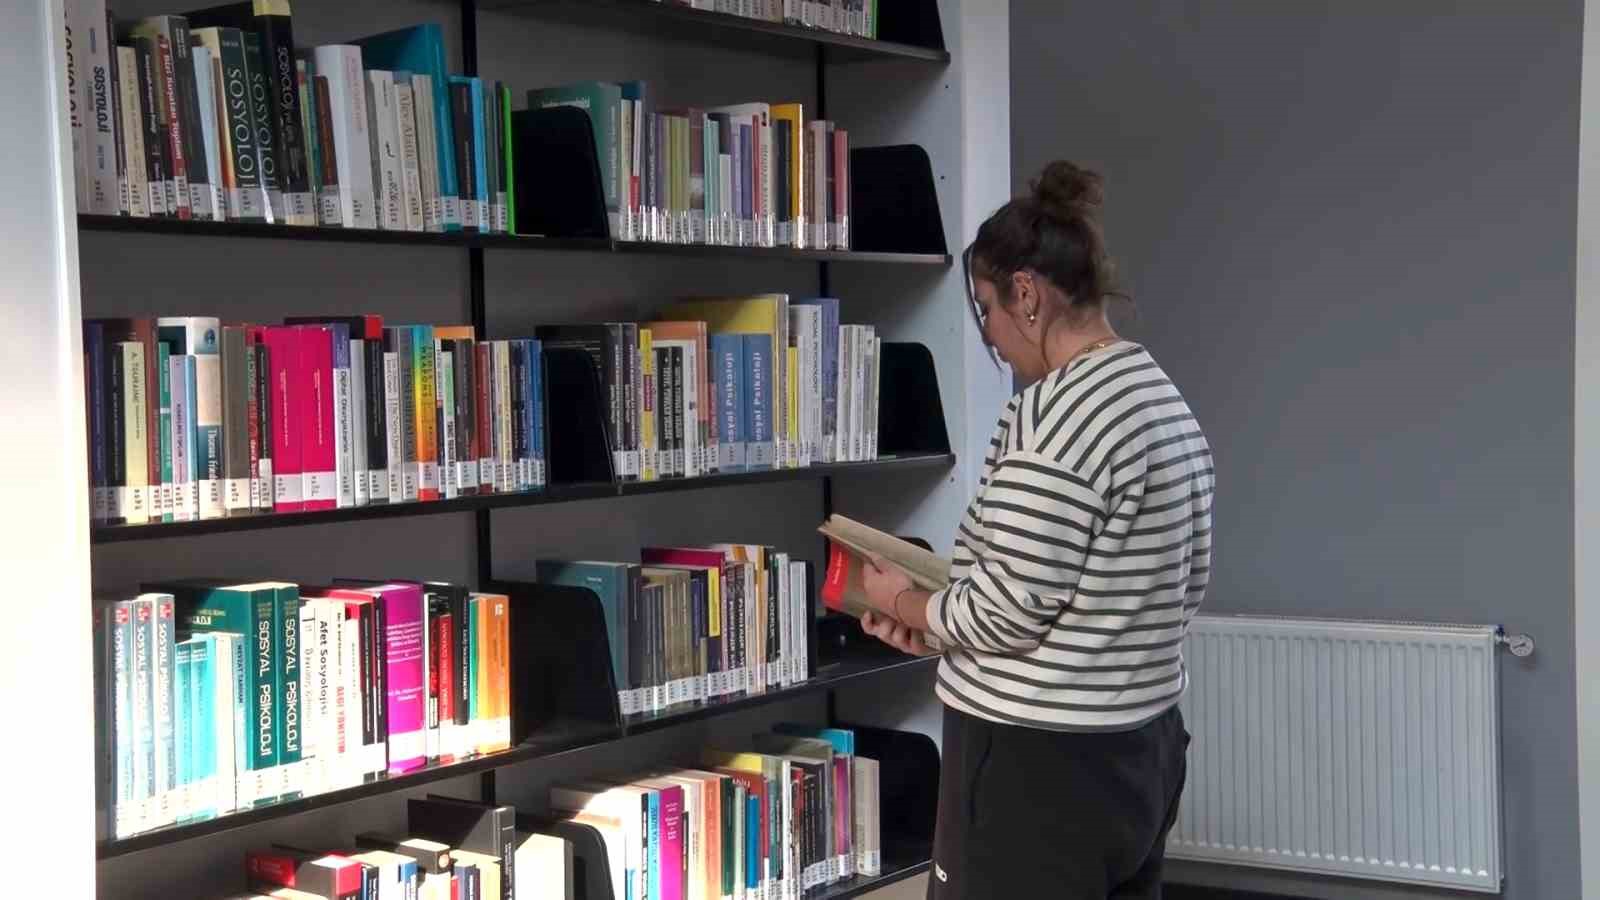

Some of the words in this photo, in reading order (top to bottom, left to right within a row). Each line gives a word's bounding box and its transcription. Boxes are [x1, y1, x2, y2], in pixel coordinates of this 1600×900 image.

[724, 411, 736, 442] osyal
[752, 410, 764, 441] osyal
[158, 623, 168, 666] SOSYAL
[259, 620, 271, 677] SOSYAL
[285, 618, 297, 675] SOSYAL
[320, 620, 329, 647] Afet
[318, 648, 329, 716] Sosyolojisi
[260, 684, 273, 757] PSİKOLOJİ
[286, 681, 298, 753] PSİKOLOJİ
